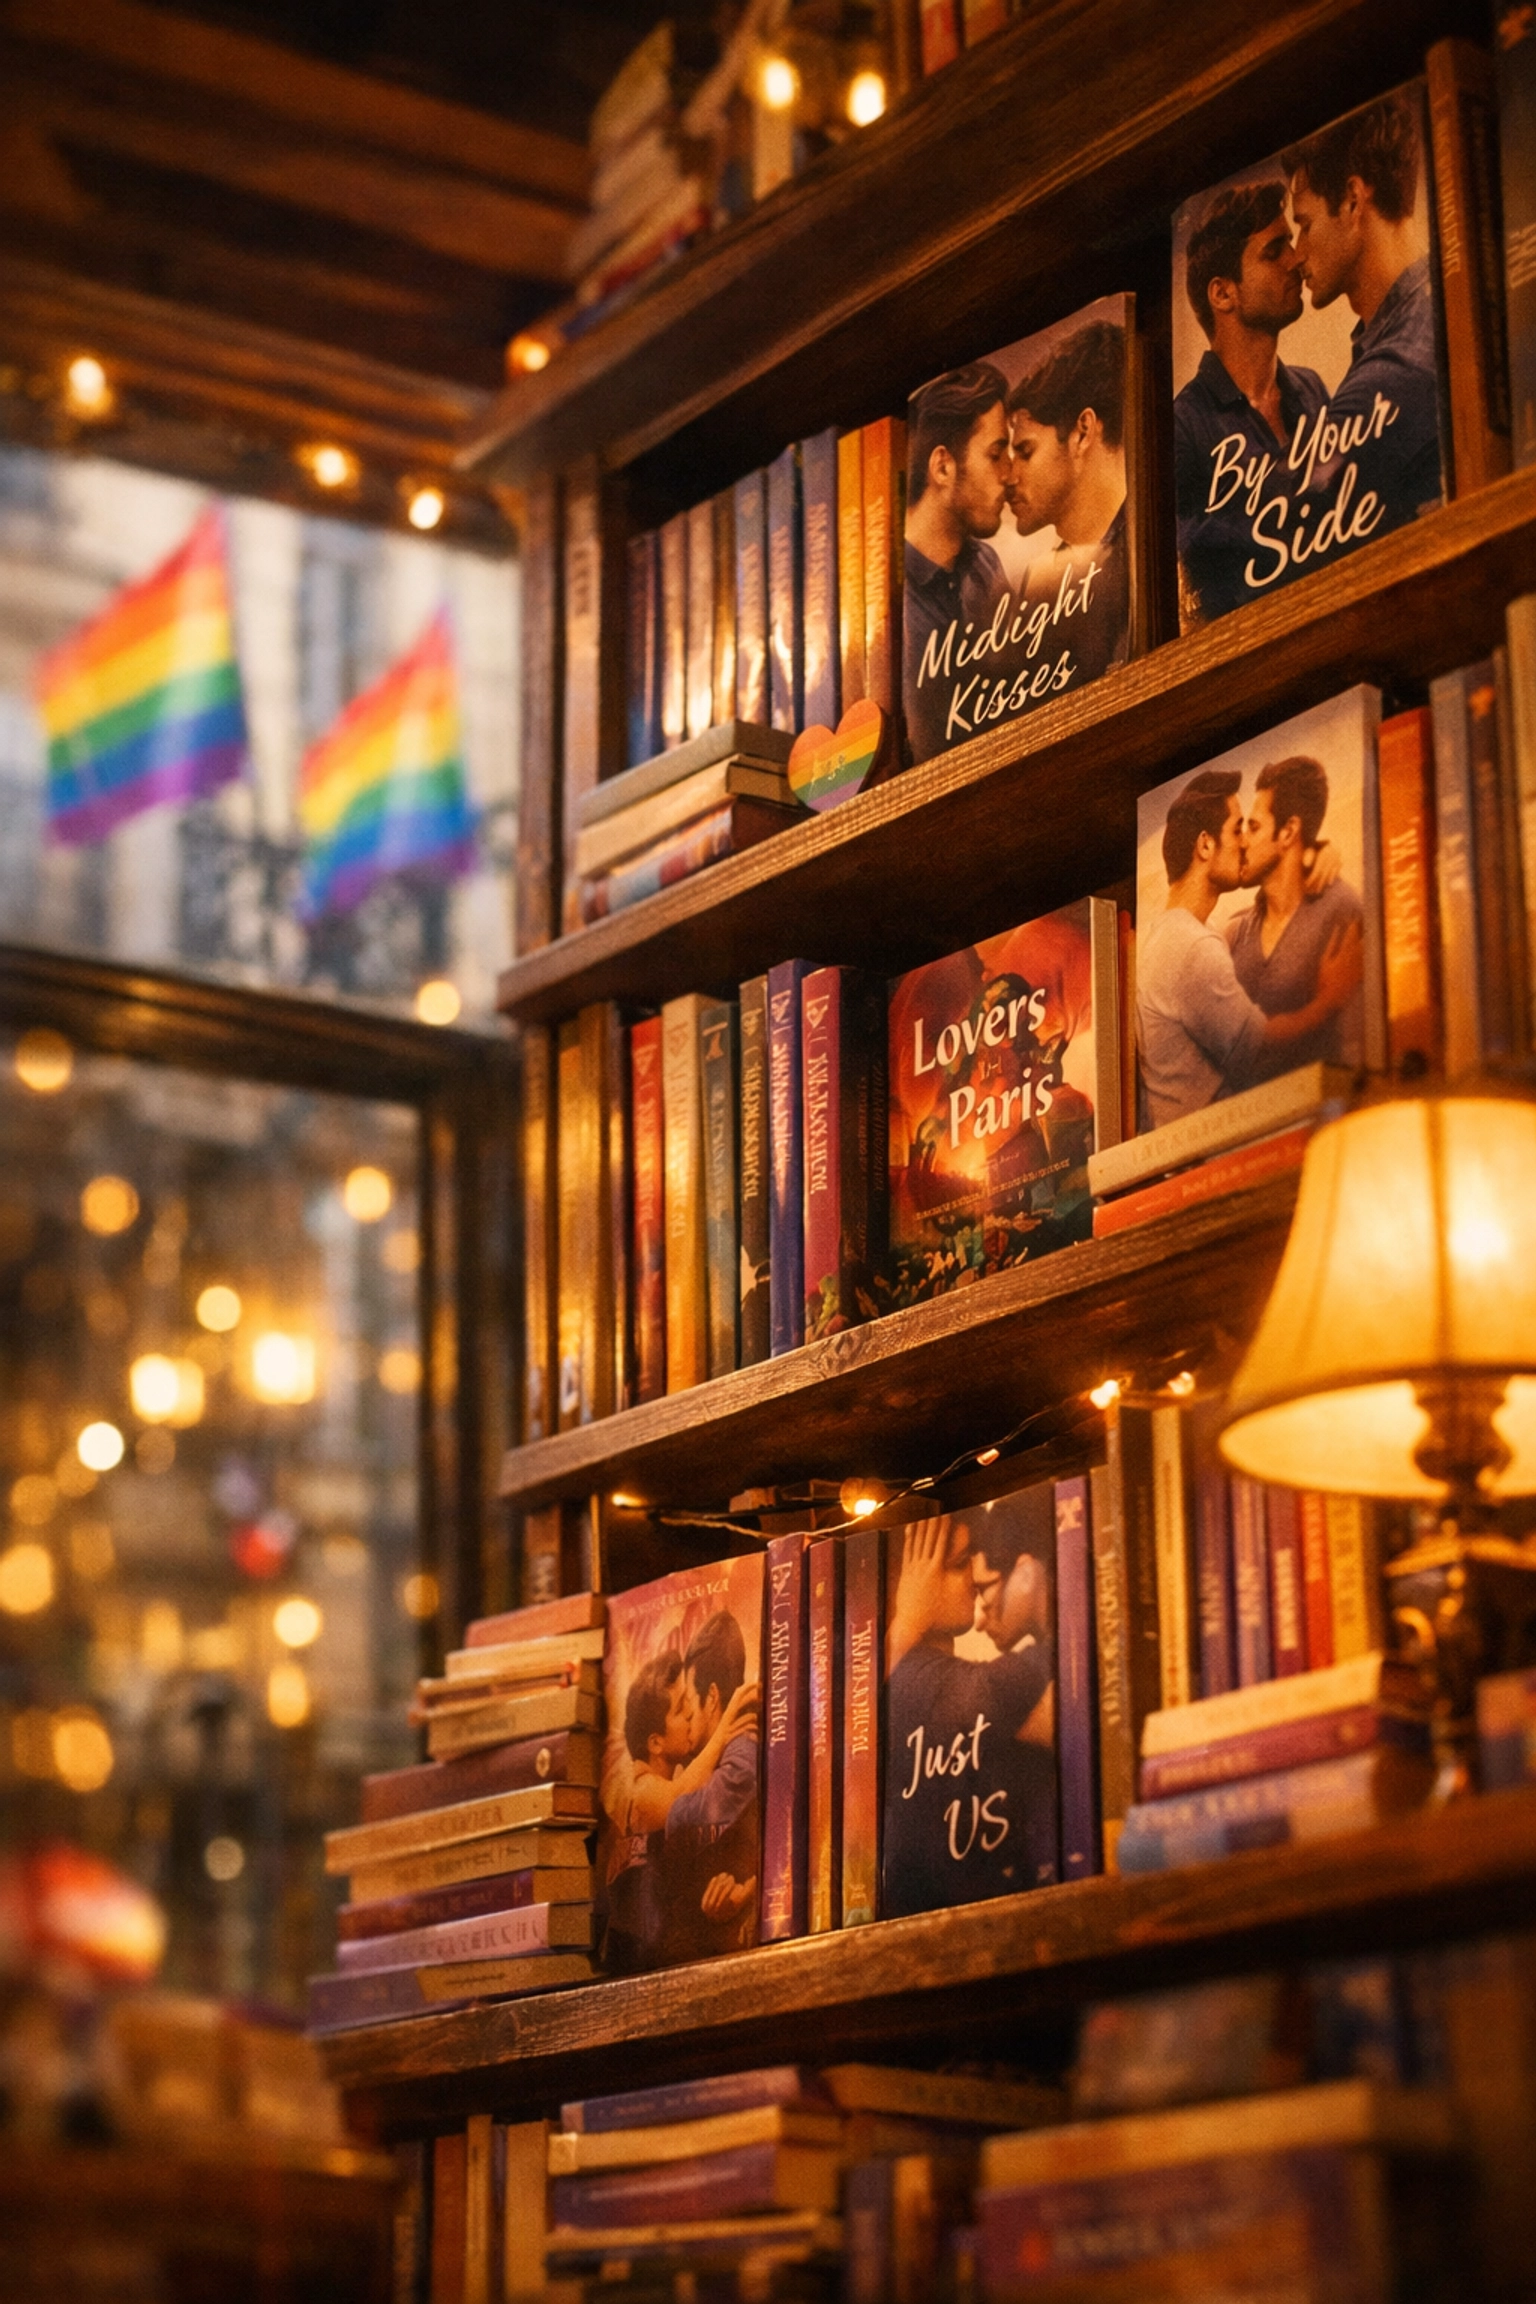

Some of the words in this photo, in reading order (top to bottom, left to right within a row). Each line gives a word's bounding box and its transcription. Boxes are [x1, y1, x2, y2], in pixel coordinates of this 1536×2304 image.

[1204, 432, 1279, 517] By
[1288, 391, 1400, 498] Your
[1243, 461, 1387, 588] Side
[945, 650, 1078, 741] Kisses
[913, 988, 1046, 1077] Lovers
[949, 1066, 1055, 1150] Paris
[901, 1712, 992, 1800] Just
